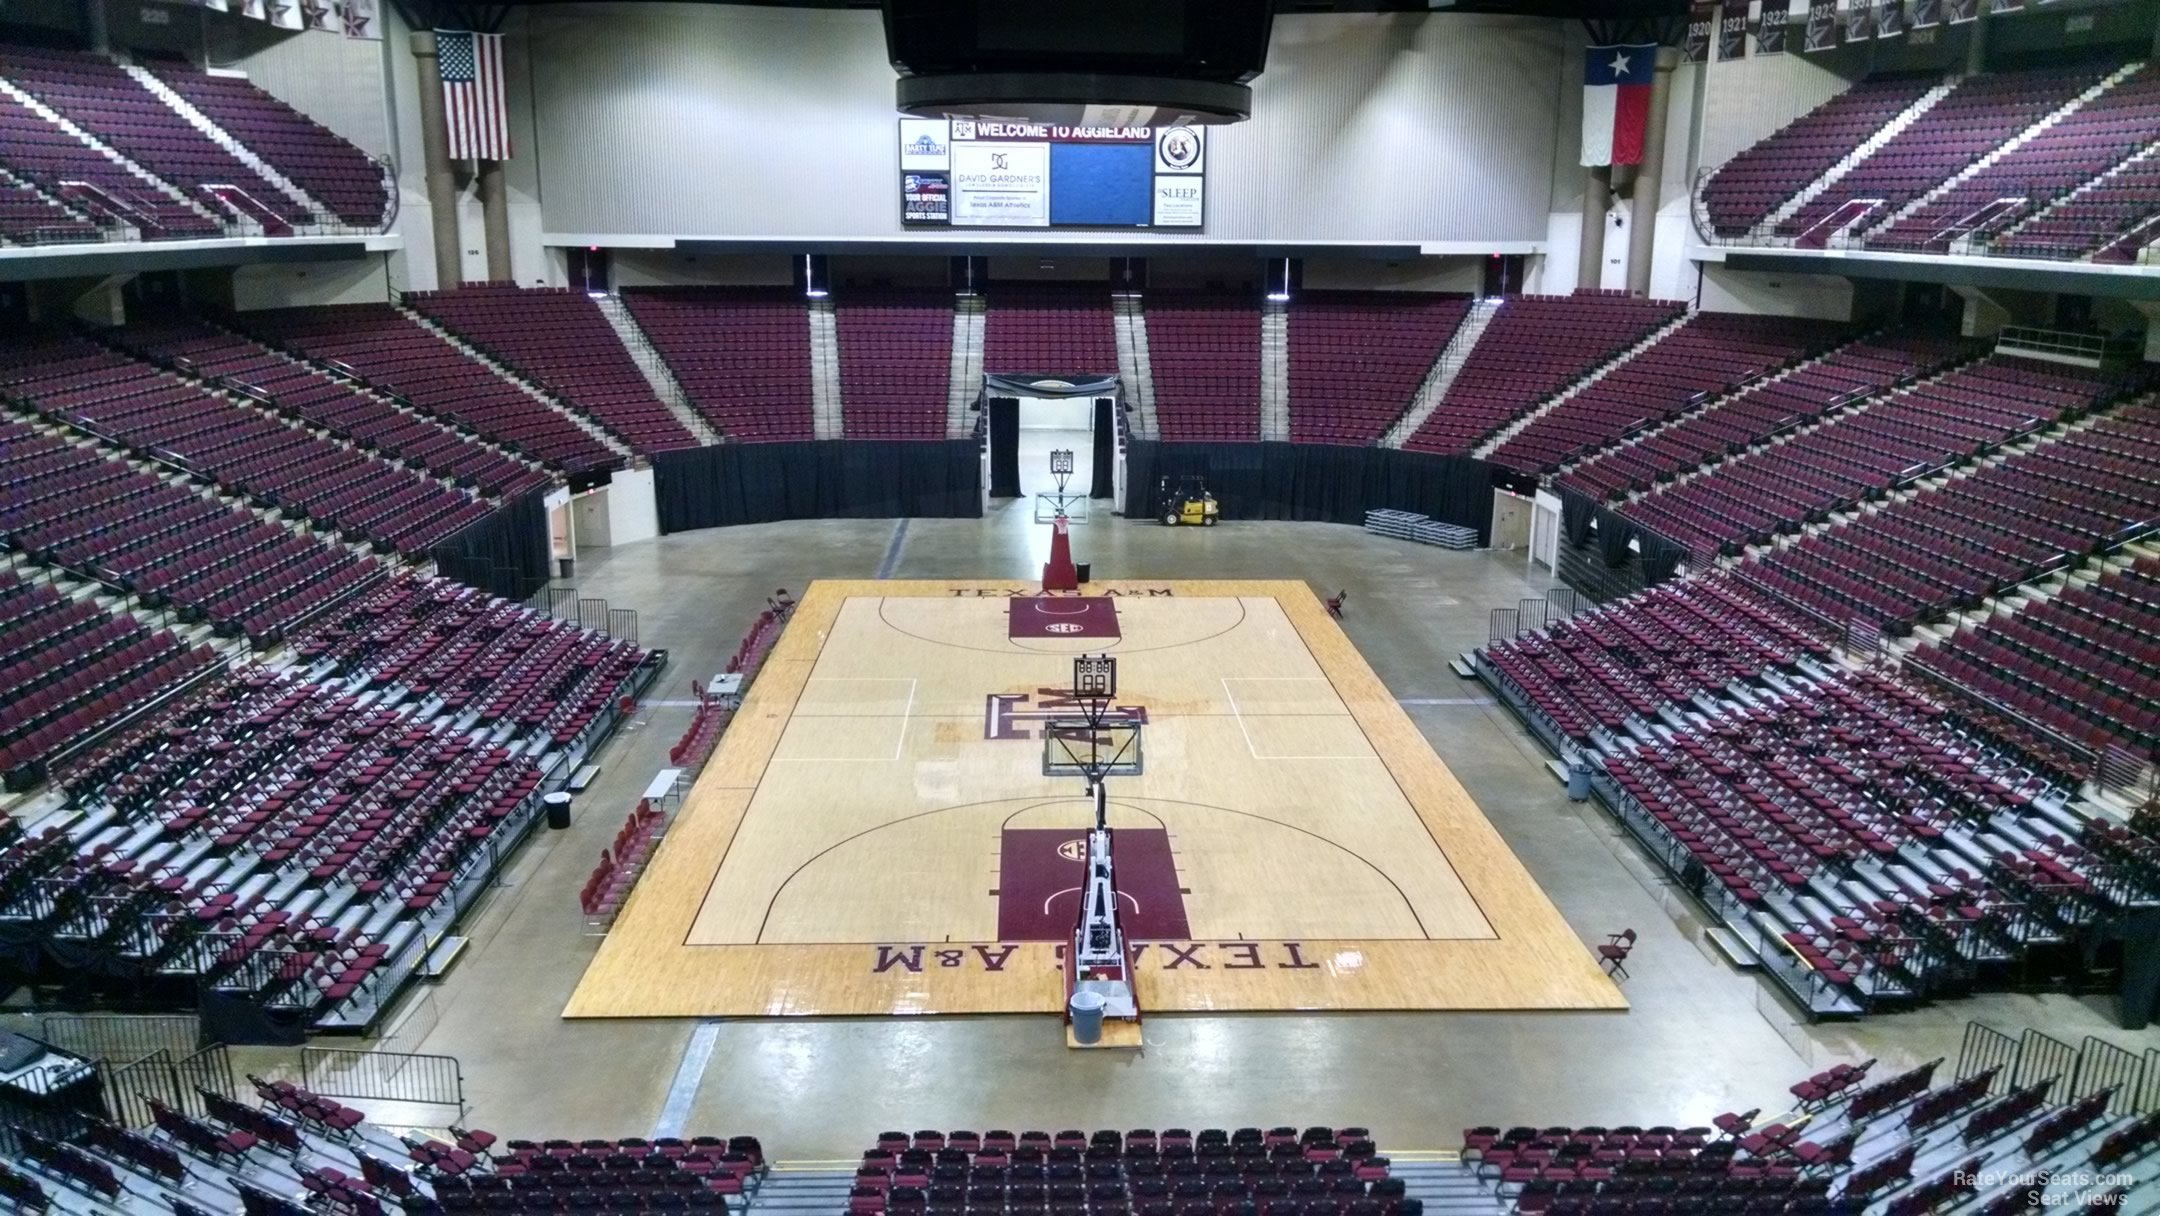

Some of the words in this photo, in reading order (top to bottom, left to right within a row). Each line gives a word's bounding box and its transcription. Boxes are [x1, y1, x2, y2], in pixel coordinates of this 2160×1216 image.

[1723, 16, 1747, 32] 1921
[1762, 10, 1788, 26] 1922
[1688, 22, 1711, 37] 1920
[978, 123, 1048, 137] WELCOME
[1052, 126, 1070, 138] TO
[1072, 126, 1151, 138] AGGIELAND
[959, 174, 987, 183] DAVID
[989, 174, 1041, 184] GARDNER'S
[1161, 188, 1197, 199] SLEEP
[906, 201, 947, 212] AGGIE
[950, 589, 1082, 597] TEXAS
[1104, 588, 1173, 597] A&M
[1049, 623, 1080, 633] SEC
[873, 944, 1018, 972] A&M
